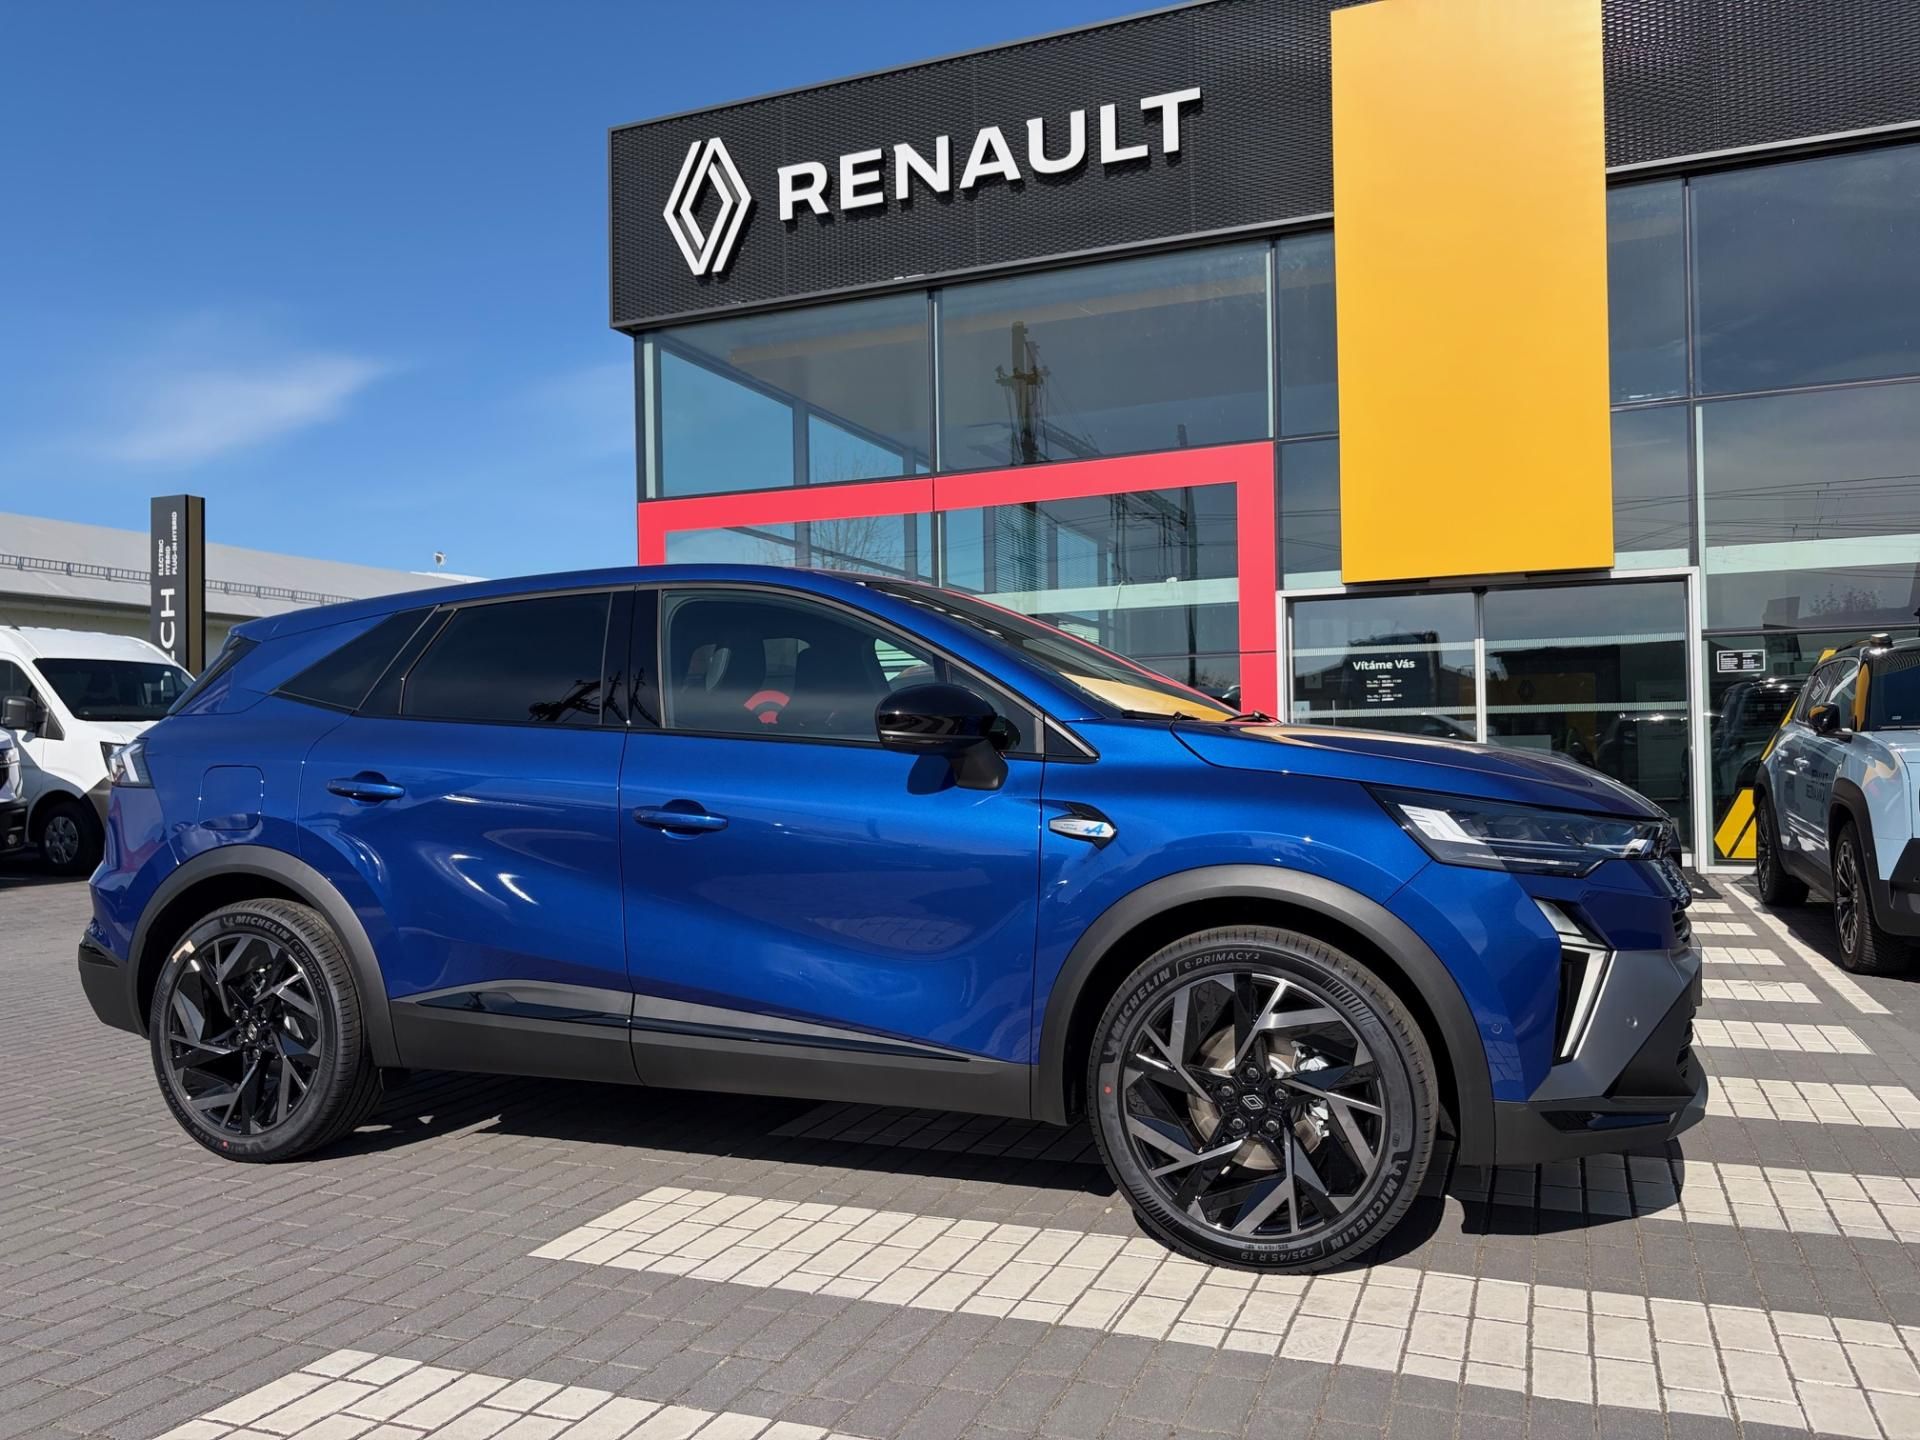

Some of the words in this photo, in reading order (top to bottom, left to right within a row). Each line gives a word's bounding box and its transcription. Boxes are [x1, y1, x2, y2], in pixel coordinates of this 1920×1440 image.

[778, 87, 1201, 221] RENAULT
[160, 588, 175, 661] CH
[1352, 660, 1393, 671] Vítáme
[1394, 659, 1416, 669] Vás
[235, 915, 291, 940] MICHELIN
[1111, 967, 1171, 1037] MICHELIN
[1329, 1177, 1399, 1252] MICHELIN
[1240, 1251, 1254, 1260] 19
[1258, 1253, 1267, 1261] R
[1271, 1247, 1313, 1262] 225/45
